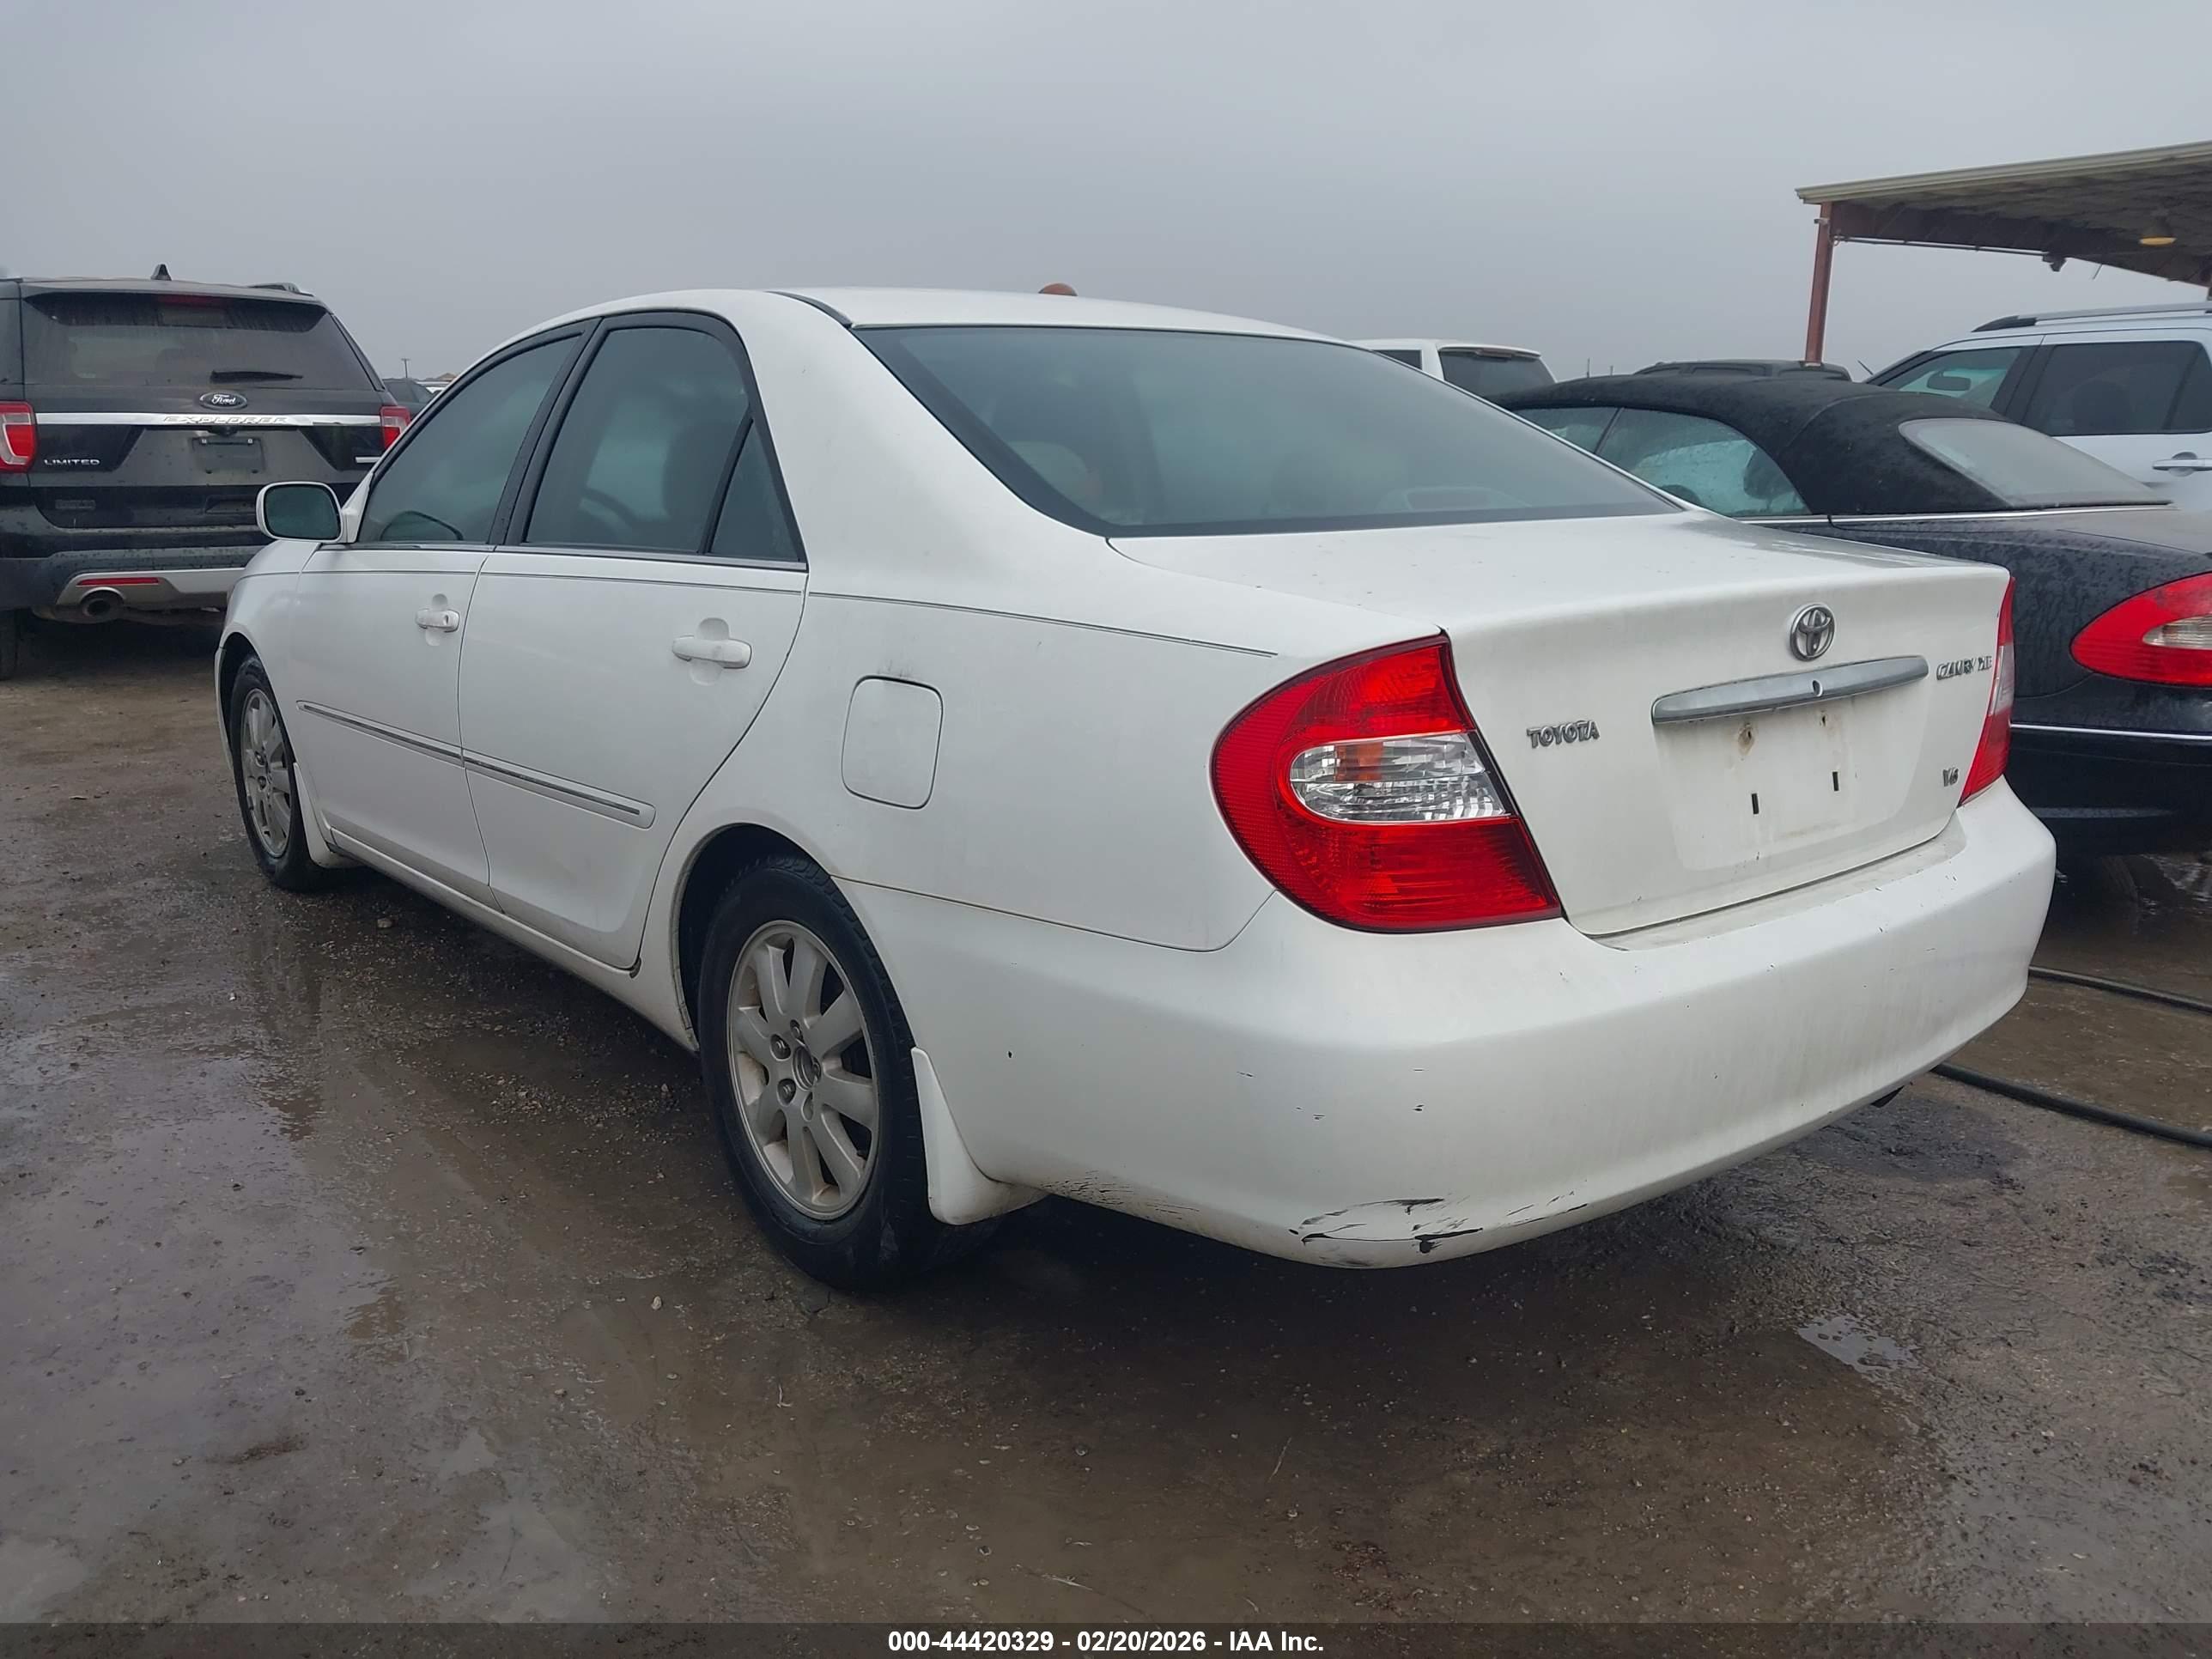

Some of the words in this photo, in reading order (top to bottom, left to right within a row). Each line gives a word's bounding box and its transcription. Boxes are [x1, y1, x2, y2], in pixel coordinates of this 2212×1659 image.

[211, 393, 236, 405] Ford
[163, 416, 289, 425] EXPLORER
[1526, 720, 1601, 749] TOYOTA
[1942, 767, 1959, 787] V6
